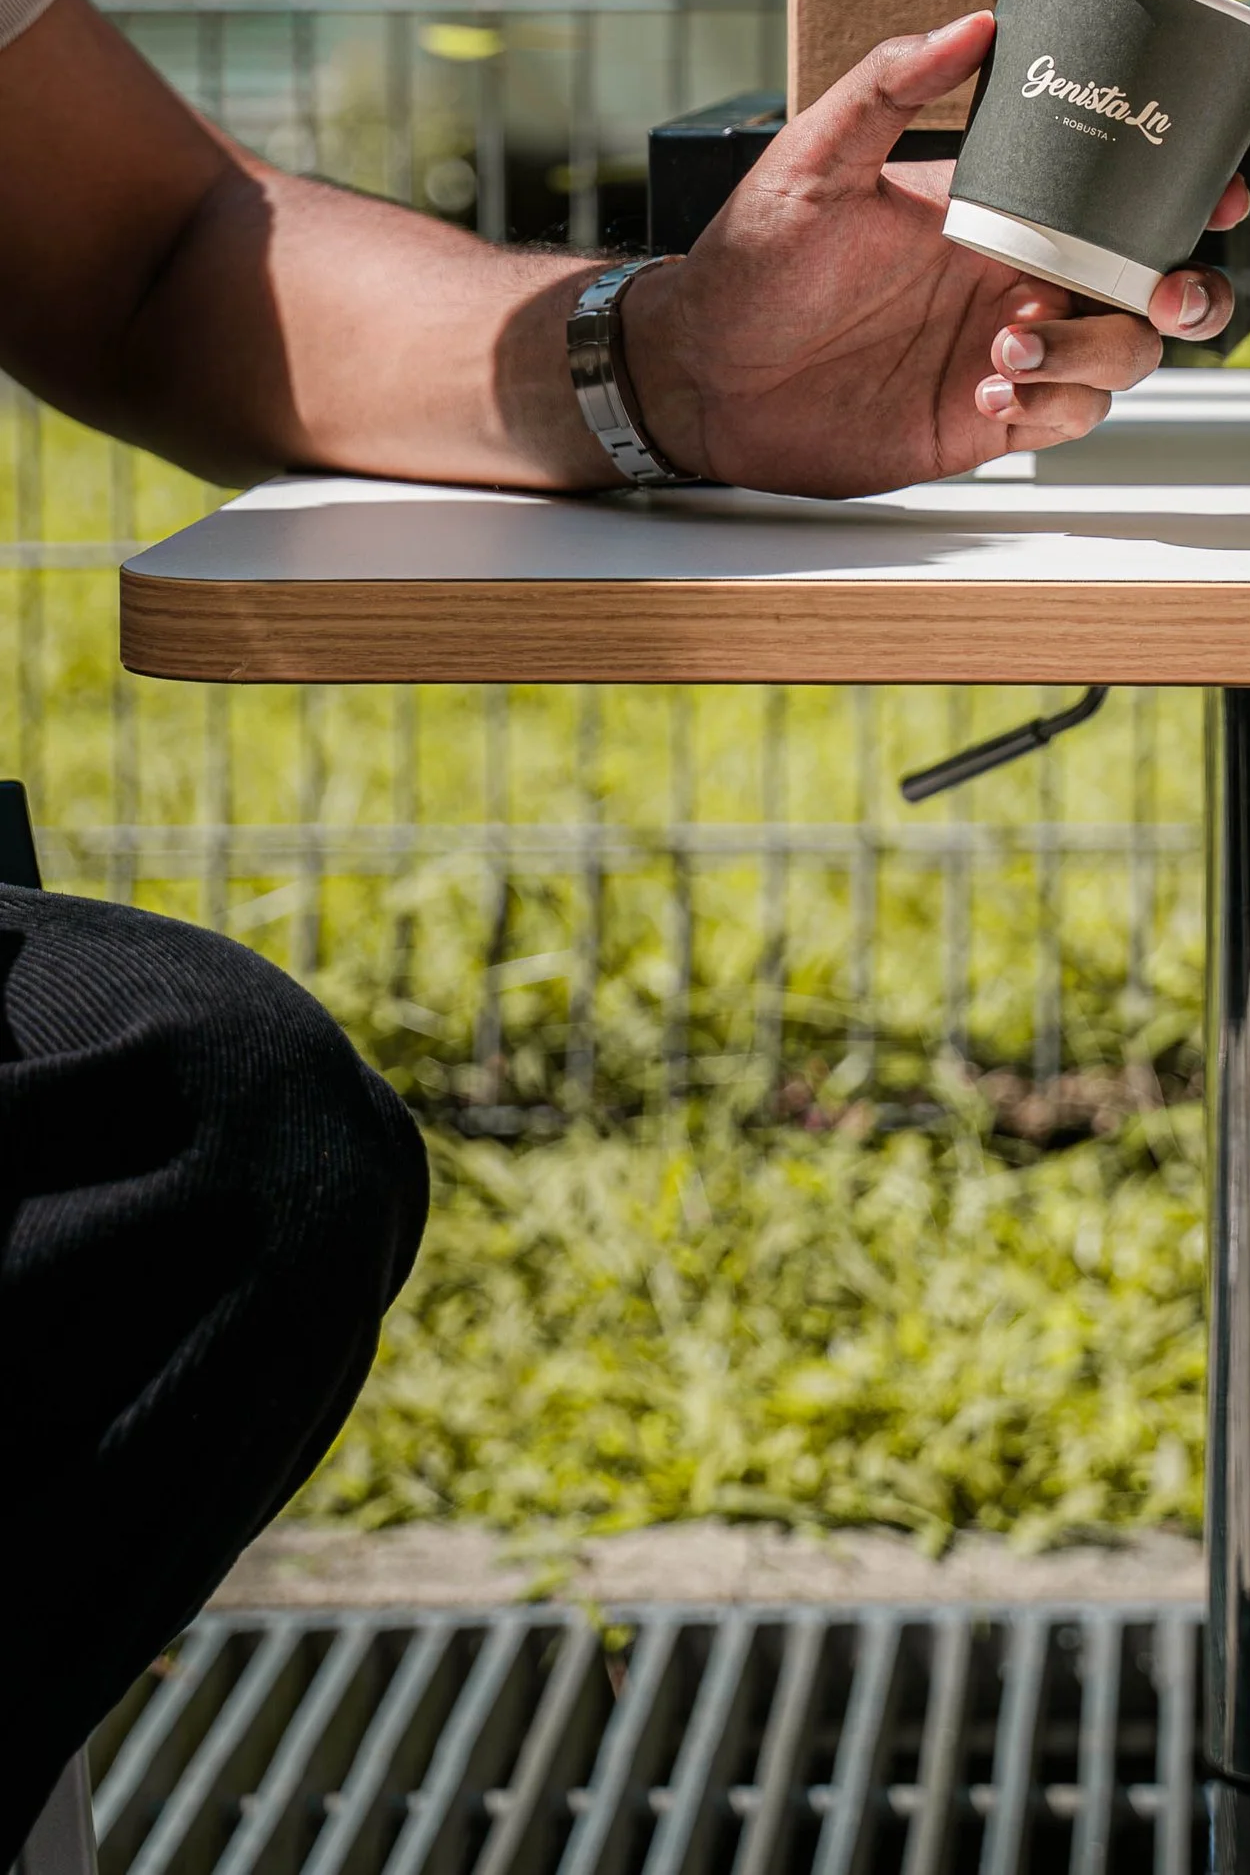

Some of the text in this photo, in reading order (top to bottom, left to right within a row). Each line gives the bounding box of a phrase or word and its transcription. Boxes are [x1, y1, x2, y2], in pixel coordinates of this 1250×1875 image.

[1021, 55, 1172, 145] Genista Ln
[1062, 116, 1109, 141] ROBUSTA
